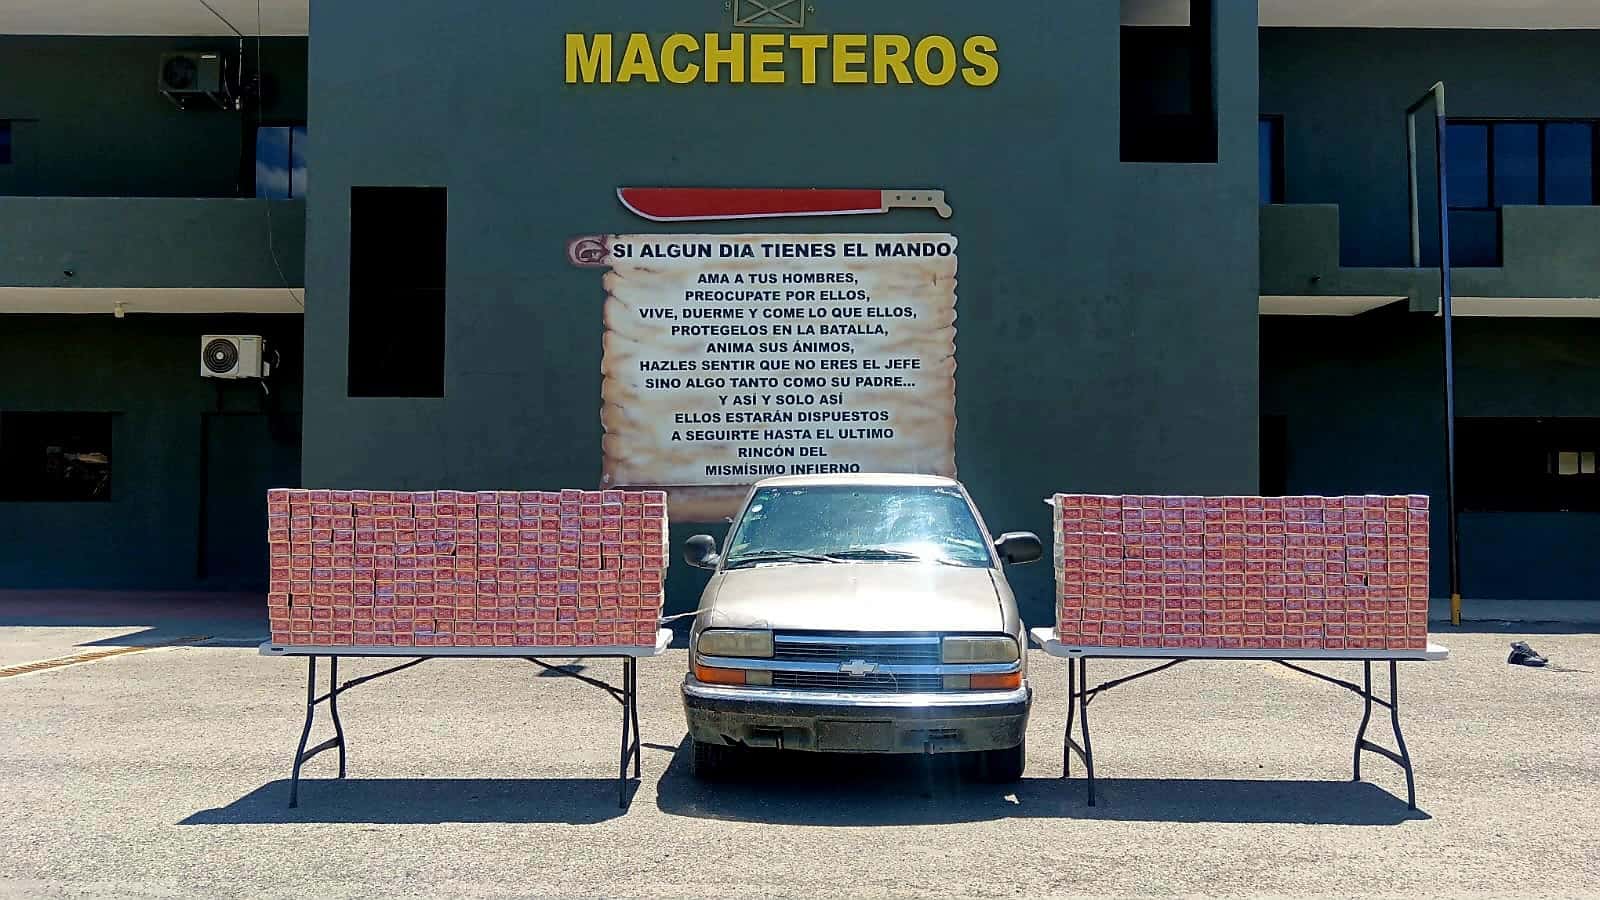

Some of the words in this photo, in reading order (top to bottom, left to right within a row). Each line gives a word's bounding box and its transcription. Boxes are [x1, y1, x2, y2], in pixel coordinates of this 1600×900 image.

[565, 33, 999, 86] MACHETEROS
[613, 243, 633, 258] SI
[639, 243, 712, 259] ALGUN
[719, 243, 755, 258] DIA
[760, 243, 836, 258] TIENES
[843, 242, 869, 258] EL
[875, 242, 952, 257] MANDO
[697, 273, 730, 284] AMA
[734, 273, 745, 284] A
[747, 273, 778, 284] TUS
[782, 272, 858, 286] HOMBRES,
[685, 290, 781, 302] PREOCUPATE
[785, 290, 816, 301] POR
[819, 289, 871, 303] ELLOS,
[638, 308, 678, 321] VIVE,
[682, 308, 744, 319] DUERME
[748, 308, 759, 319] Y
[762, 307, 805, 319] COME
[808, 307, 828, 318] LO
[831, 307, 863, 319] QUE
[866, 306, 917, 319] ELLOS,
[671, 324, 768, 336] PROTEGELOS
[772, 324, 792, 336] EN
[797, 324, 816, 336] LA
[819, 324, 889, 337] BATALLA,
[706, 342, 755, 353] ANIMA
[759, 342, 788, 353] SUS
[792, 339, 855, 355] ÁNIMOS,
[639, 360, 697, 372] HAZLES
[701, 359, 756, 371] SENTIR
[759, 359, 791, 371] QUE
[794, 359, 816, 370] NO
[820, 359, 858, 370] ERES
[862, 359, 881, 370] EL
[884, 358, 921, 370] JEFE
[645, 378, 682, 389] SINO
[685, 377, 726, 389] ALGO
[729, 377, 779, 388] TANTO
[783, 376, 827, 388] COMO
[830, 376, 851, 388] SU
[855, 376, 916, 387] PADRE...
[718, 395, 729, 406] Y
[732, 392, 757, 406] ASÍ
[761, 394, 772, 406] Y
[775, 394, 815, 406] SOLO
[819, 391, 843, 405] ASÍ
[674, 412, 722, 424] ELLOS
[725, 409, 793, 425] ESTARÁN
[797, 410, 889, 423] DISPUESTOS
[671, 430, 682, 442] A
[685, 429, 760, 441] SEGUIRTE
[763, 429, 812, 441] HASTA
[816, 428, 835, 440] EL
[838, 428, 894, 439] ULTIMO
[738, 444, 795, 458] RINCÓN
[799, 446, 828, 457] DEL
[705, 462, 786, 476] MISMÍSIMO
[790, 463, 860, 476] INFIERNO
